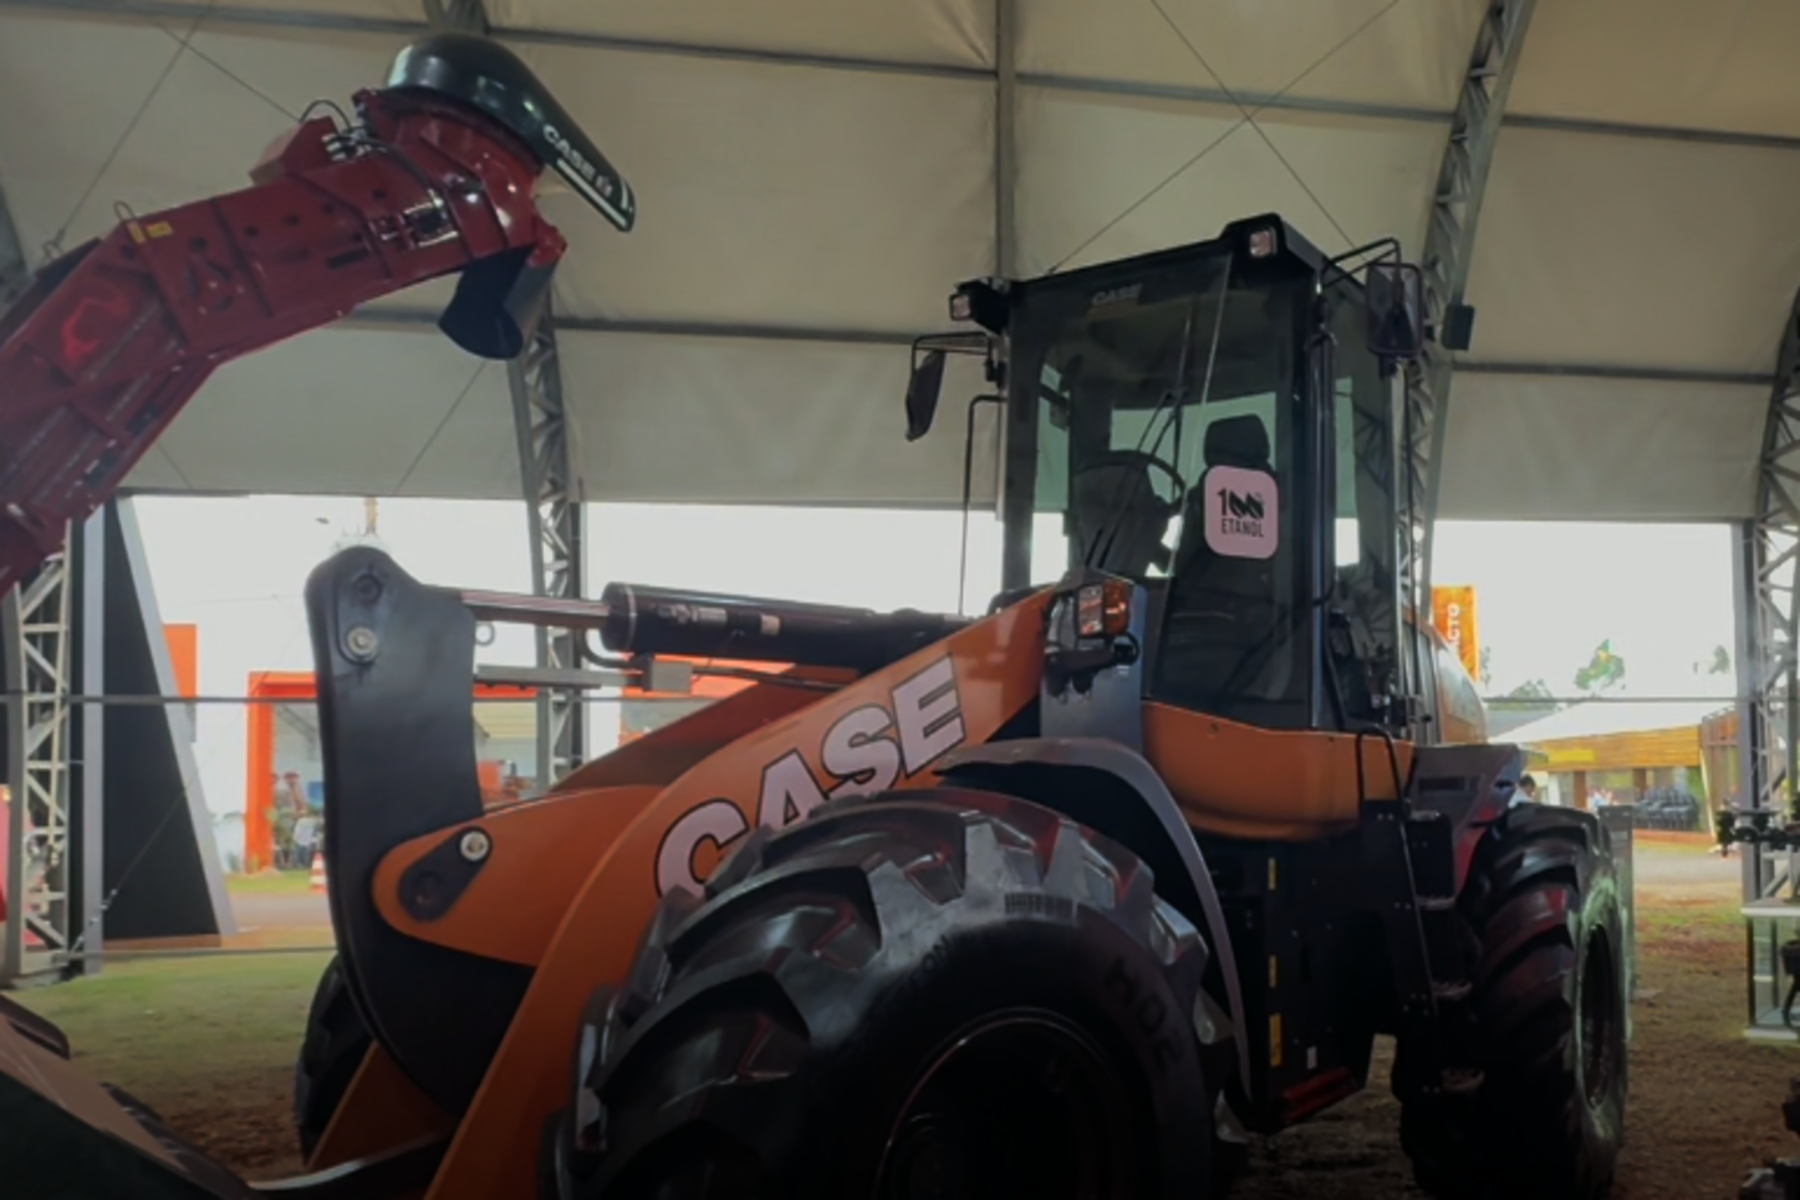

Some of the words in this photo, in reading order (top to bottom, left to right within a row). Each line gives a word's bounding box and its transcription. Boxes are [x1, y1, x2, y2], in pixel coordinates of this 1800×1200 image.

[543, 125, 596, 181] CASE
[1221, 518, 1264, 537] ETANOL
[655, 653, 966, 900] CASE
